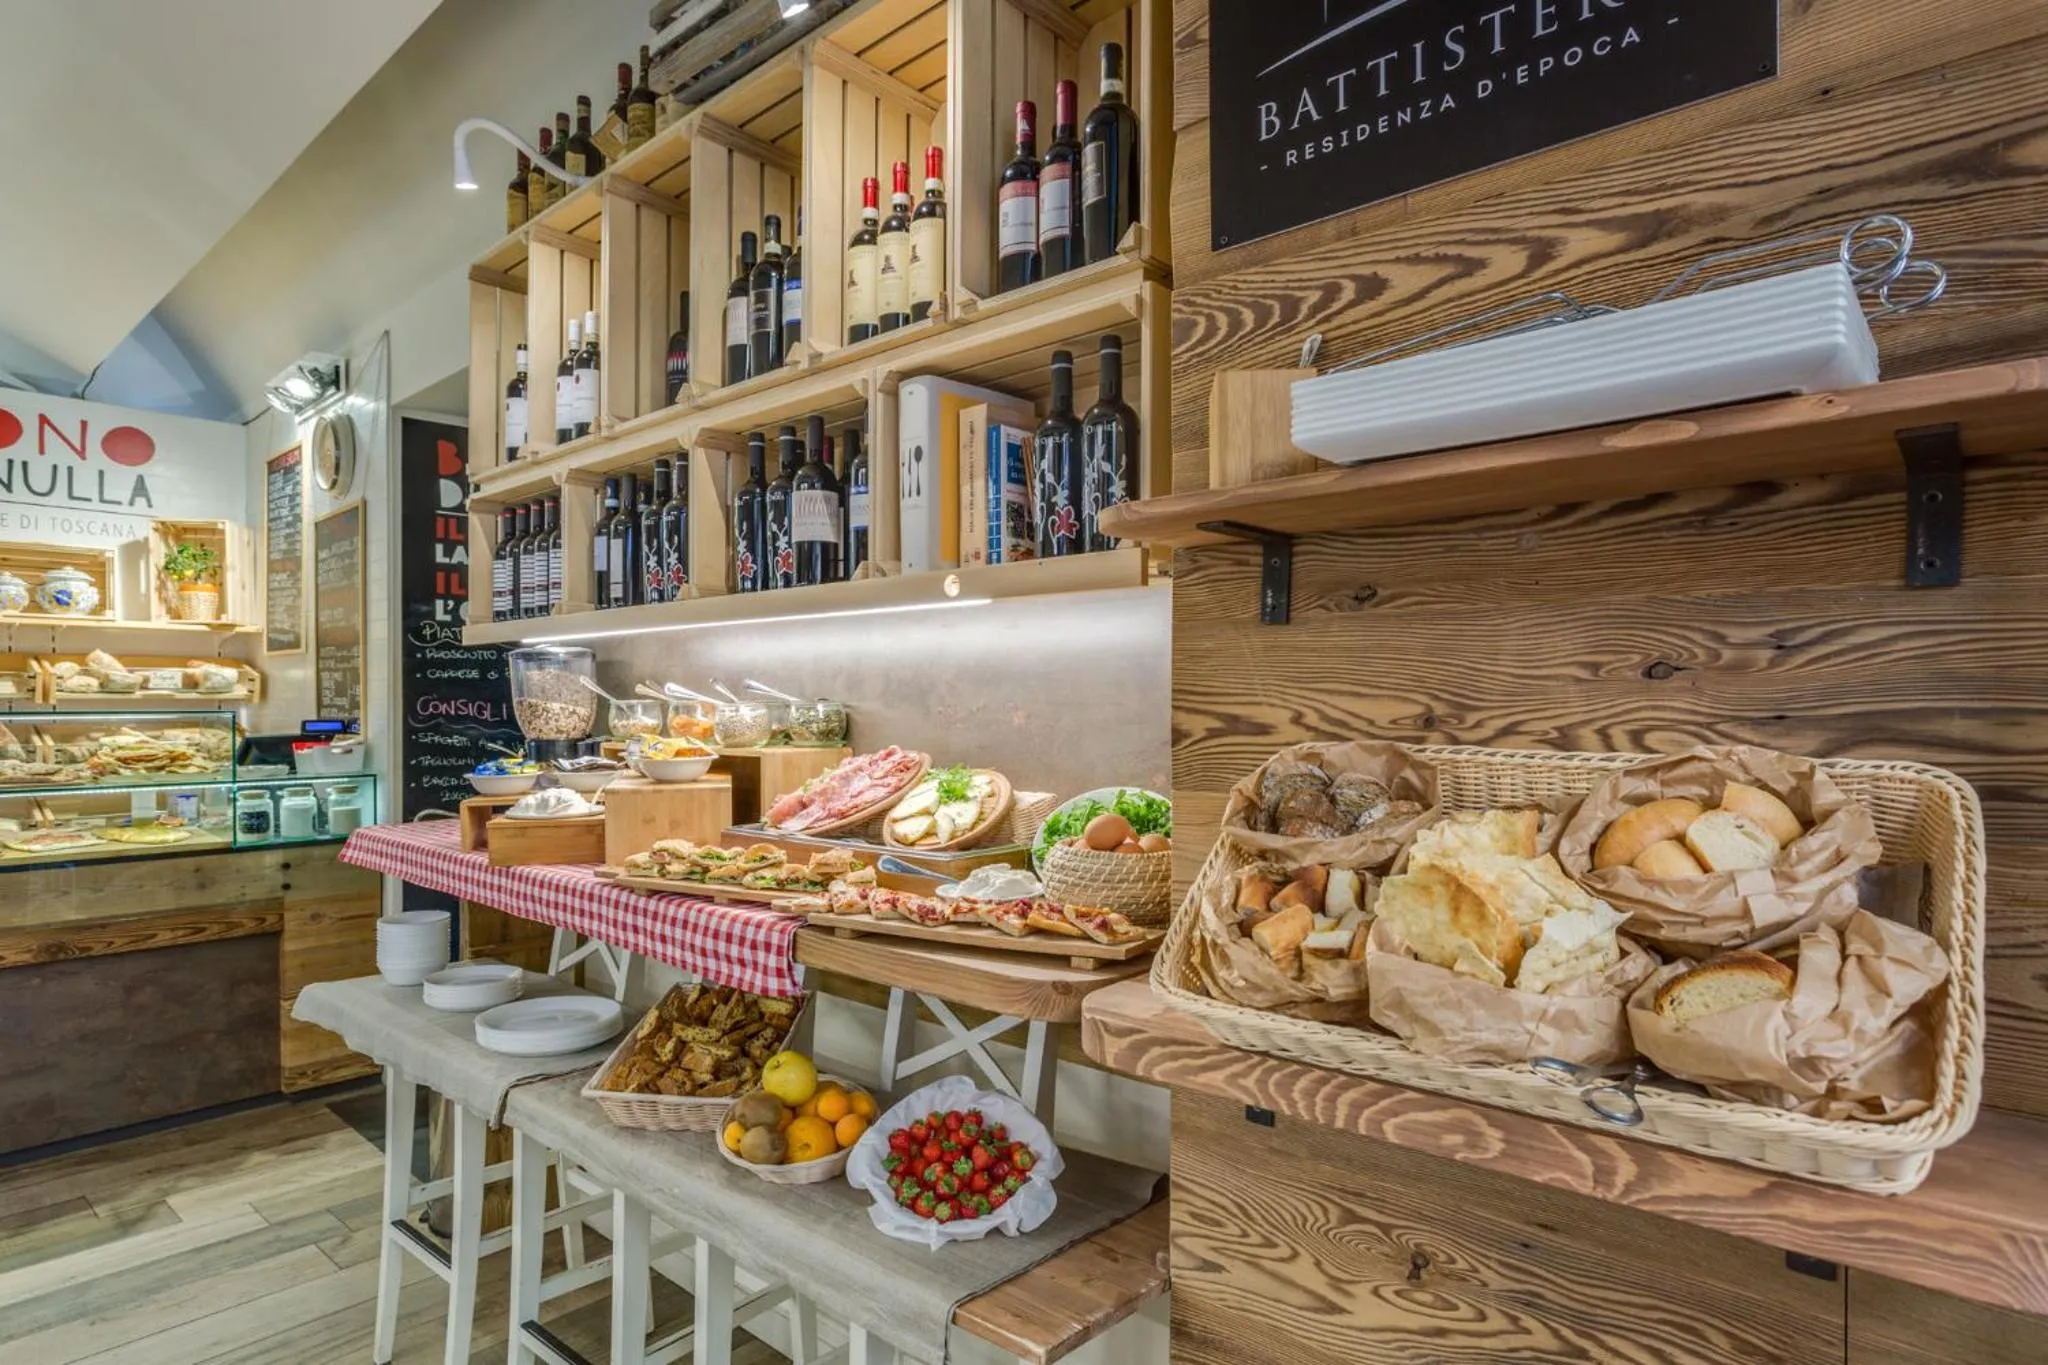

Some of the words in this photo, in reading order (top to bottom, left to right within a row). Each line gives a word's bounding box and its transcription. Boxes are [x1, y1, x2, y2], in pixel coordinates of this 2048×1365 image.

[1285, 93, 1457, 168] RESIDENZA
[1477, 26, 1642, 99] D'EPOCA
[20, 513, 38, 531] DI
[50, 517, 137, 538] TOSCANA
[419, 621, 463, 641] PIAT
